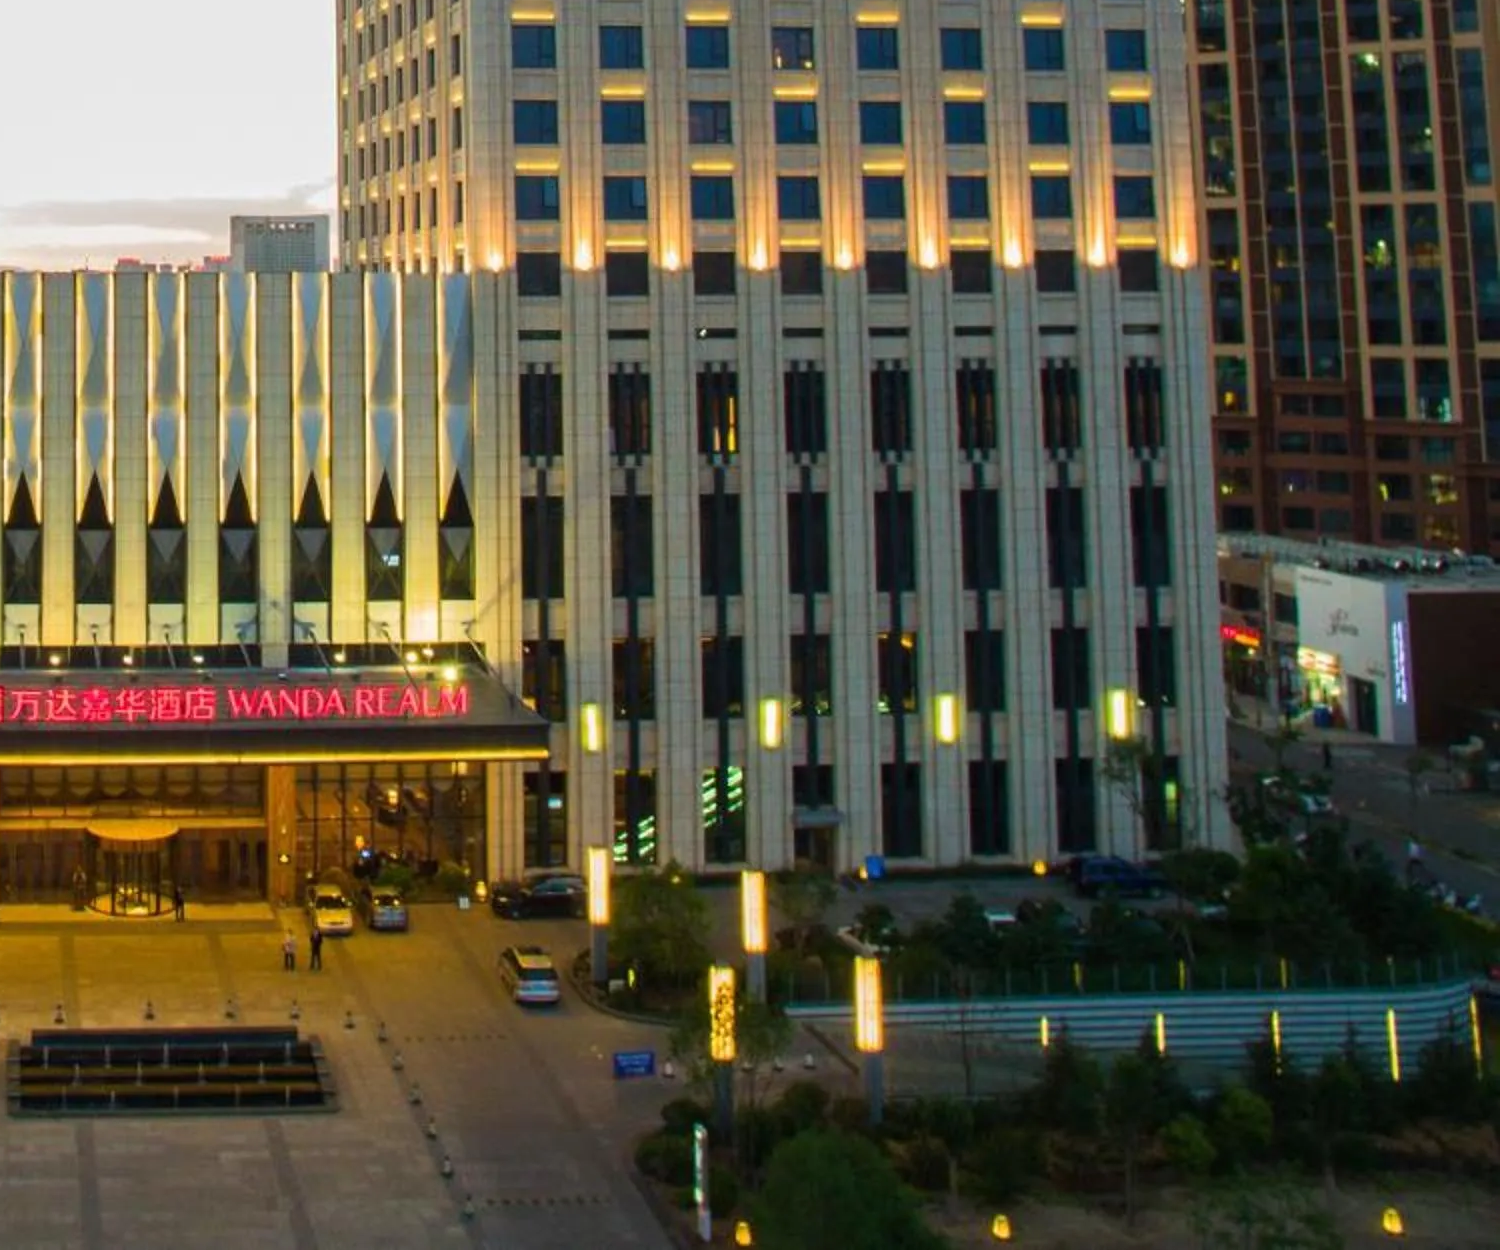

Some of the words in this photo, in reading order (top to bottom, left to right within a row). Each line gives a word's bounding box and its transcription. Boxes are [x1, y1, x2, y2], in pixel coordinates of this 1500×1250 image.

[10, 686, 218, 722] 万达嘉华酒店
[227, 686, 345, 719] WANDA
[354, 684, 468, 718] REALM
